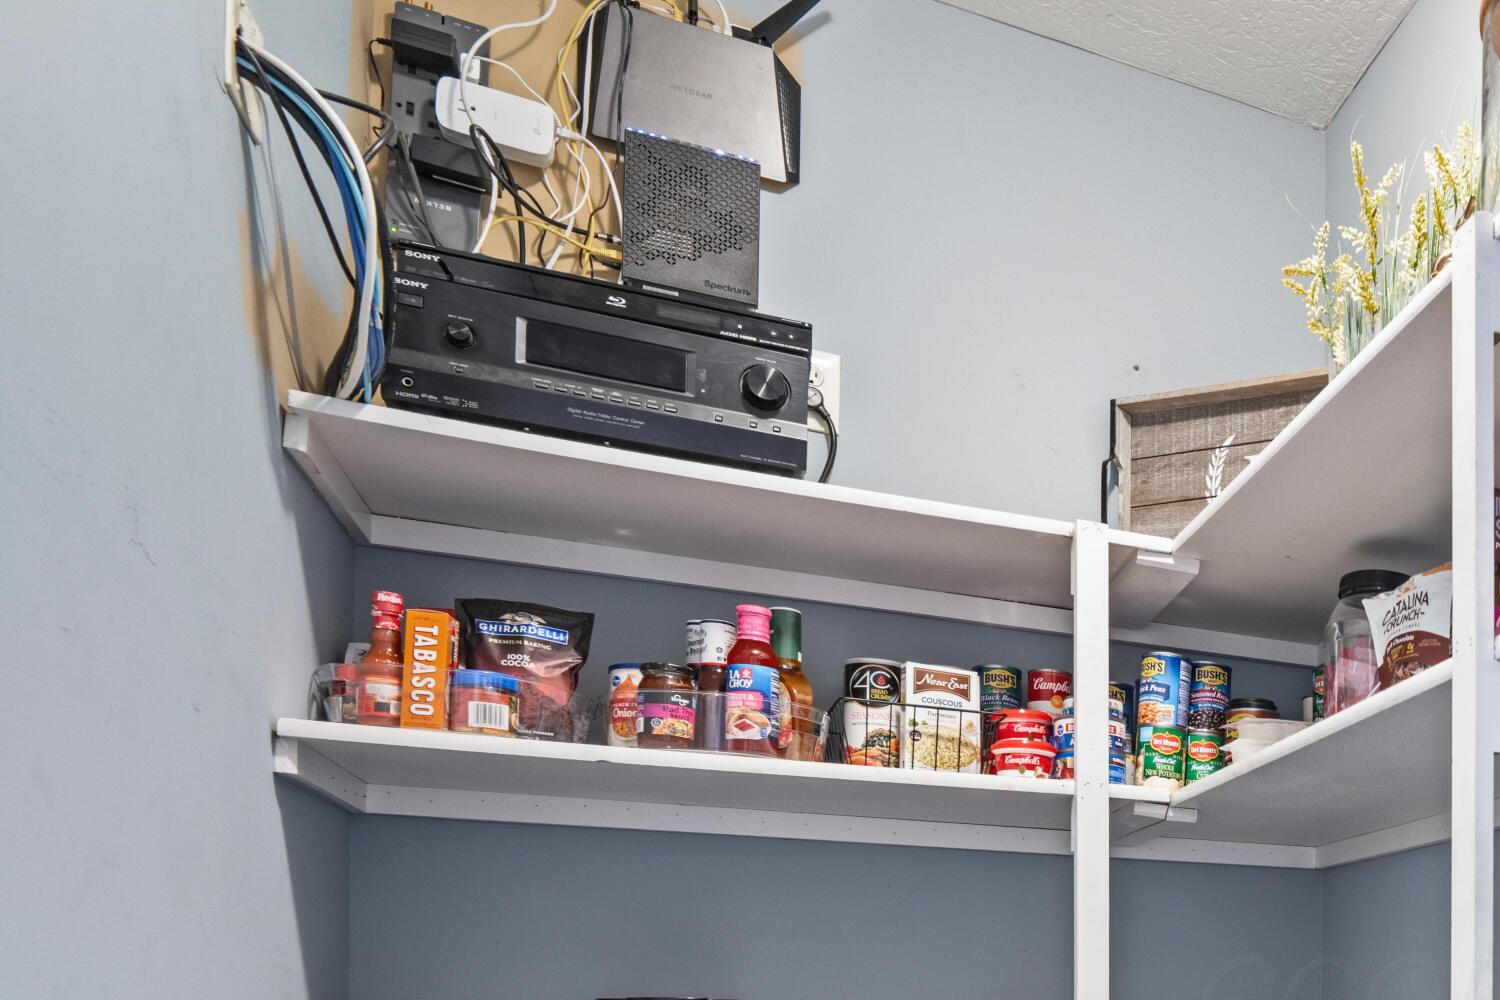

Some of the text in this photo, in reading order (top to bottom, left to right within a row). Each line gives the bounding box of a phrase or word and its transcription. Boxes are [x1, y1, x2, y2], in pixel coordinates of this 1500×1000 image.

[670, 83, 713, 101] NETGEAR
[404, 250, 441, 262] SONY
[394, 277, 428, 290] SONY
[704, 279, 752, 297] Spectrum
[1382, 590, 1429, 626] CATALINA
[1385, 608, 1422, 633] CRUNCH
[479, 622, 565, 641] GHIRARDELLI
[524, 640, 551, 650] BAKING
[507, 653, 530, 661] 100%
[410, 625, 438, 716] TABASCO
[501, 660, 535, 669] COCOA
[729, 670, 740, 679] LA
[984, 673, 1016, 687] BUSH'S
[1197, 669, 1227, 683] BUSH'S
[729, 679, 753, 688] CHOY
[853, 669, 892, 704] 4C
[917, 673, 969, 691] Near East
[1191, 690, 1216, 698] Seasoned
[921, 696, 963, 708] COUSCOUS
[663, 705, 679, 714] Pad
[928, 710, 956, 719] Parmesan
[1013, 722, 1046, 734] Campbell's
[1005, 755, 1040, 766] Campbell's
[1155, 763, 1175, 771] WHOLE
